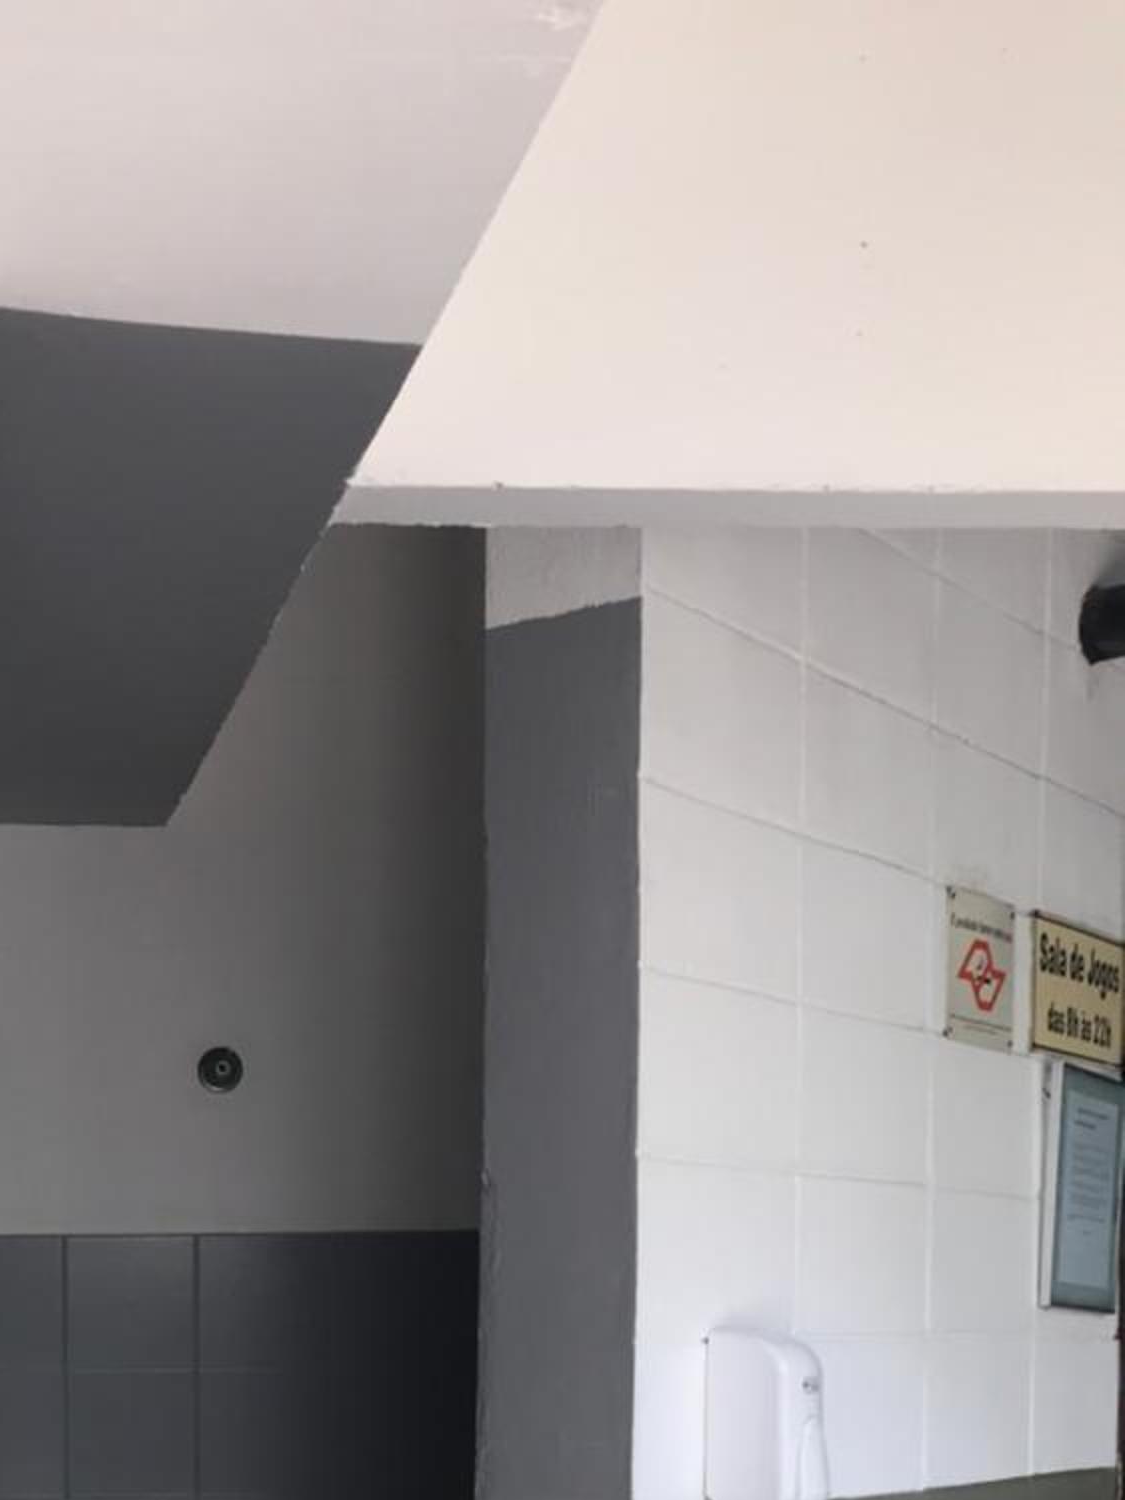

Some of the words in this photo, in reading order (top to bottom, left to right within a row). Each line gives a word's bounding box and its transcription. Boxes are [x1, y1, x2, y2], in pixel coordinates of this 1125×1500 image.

[1039, 932, 1066, 978] Sala
[1070, 943, 1084, 983] de
[1087, 947, 1120, 1001] Jogos
